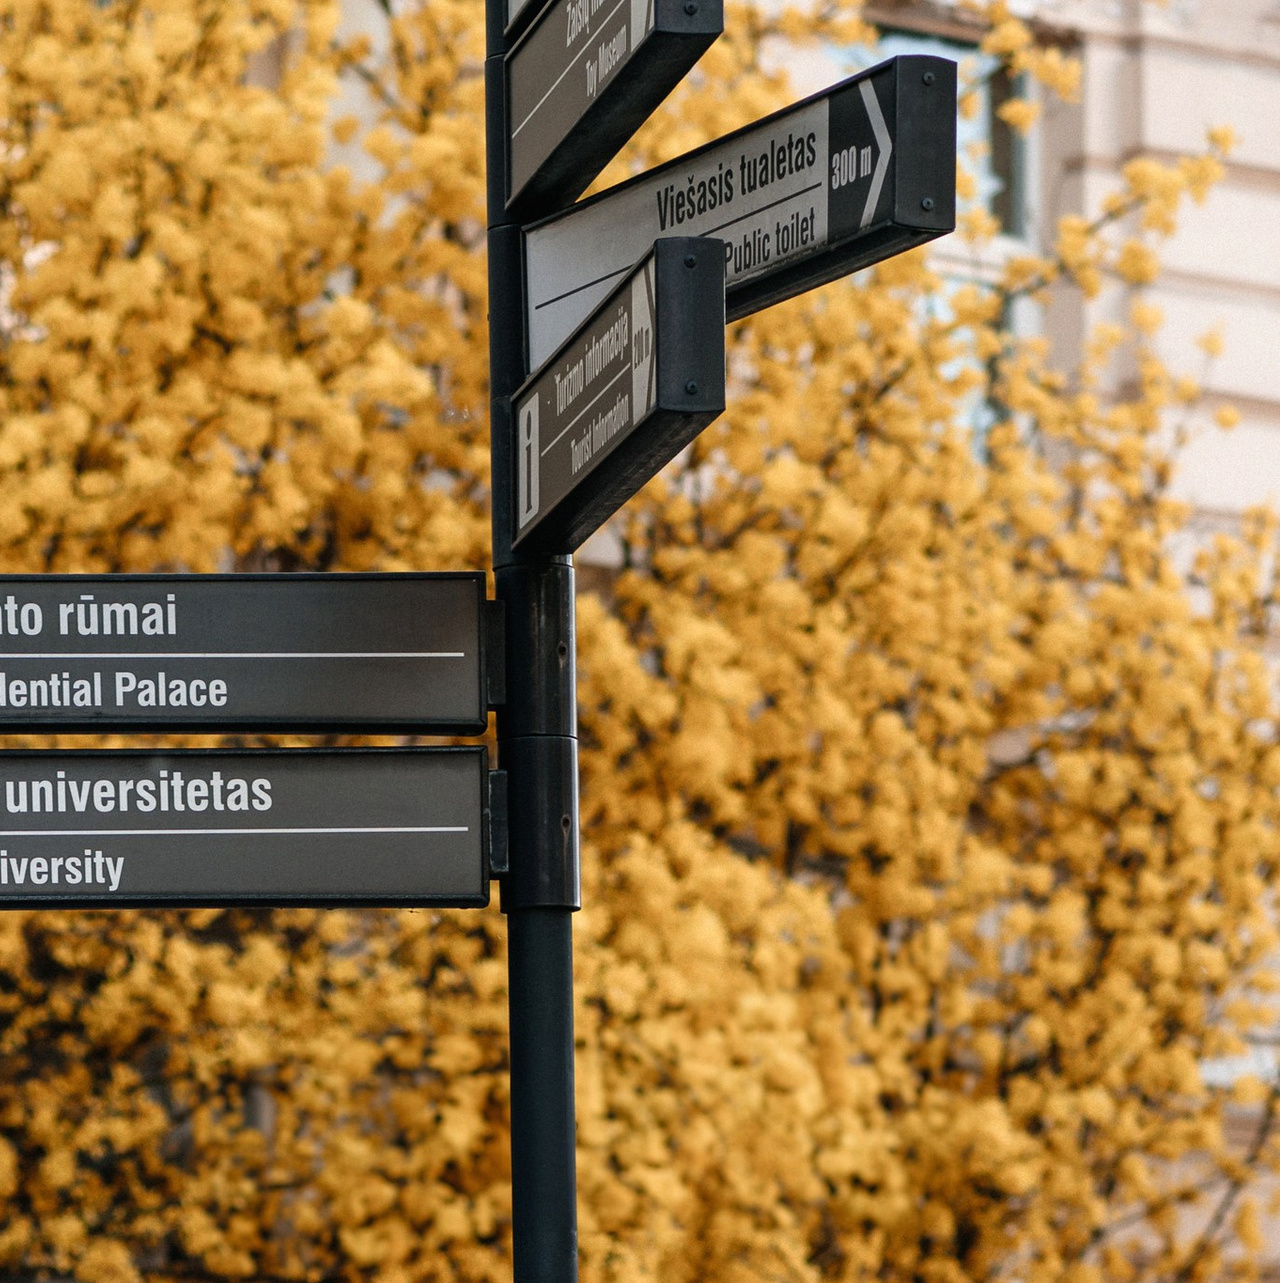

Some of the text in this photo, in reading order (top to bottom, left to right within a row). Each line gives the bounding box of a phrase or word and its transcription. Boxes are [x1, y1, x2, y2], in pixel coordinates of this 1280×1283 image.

[586, 60, 597, 97] Toy
[599, 24, 626, 83] Museum
[656, 132, 816, 231] Viešasis tualetas
[831, 145, 872, 190] 300 m
[724, 207, 815, 277] Public toilet
[555, 306, 628, 416] Turizmo informacija
[571, 424, 592, 475] Tourist
[59, 593, 178, 636] rūmai
[115, 672, 228, 707] Palace
[5, 770, 273, 814] universitetas
